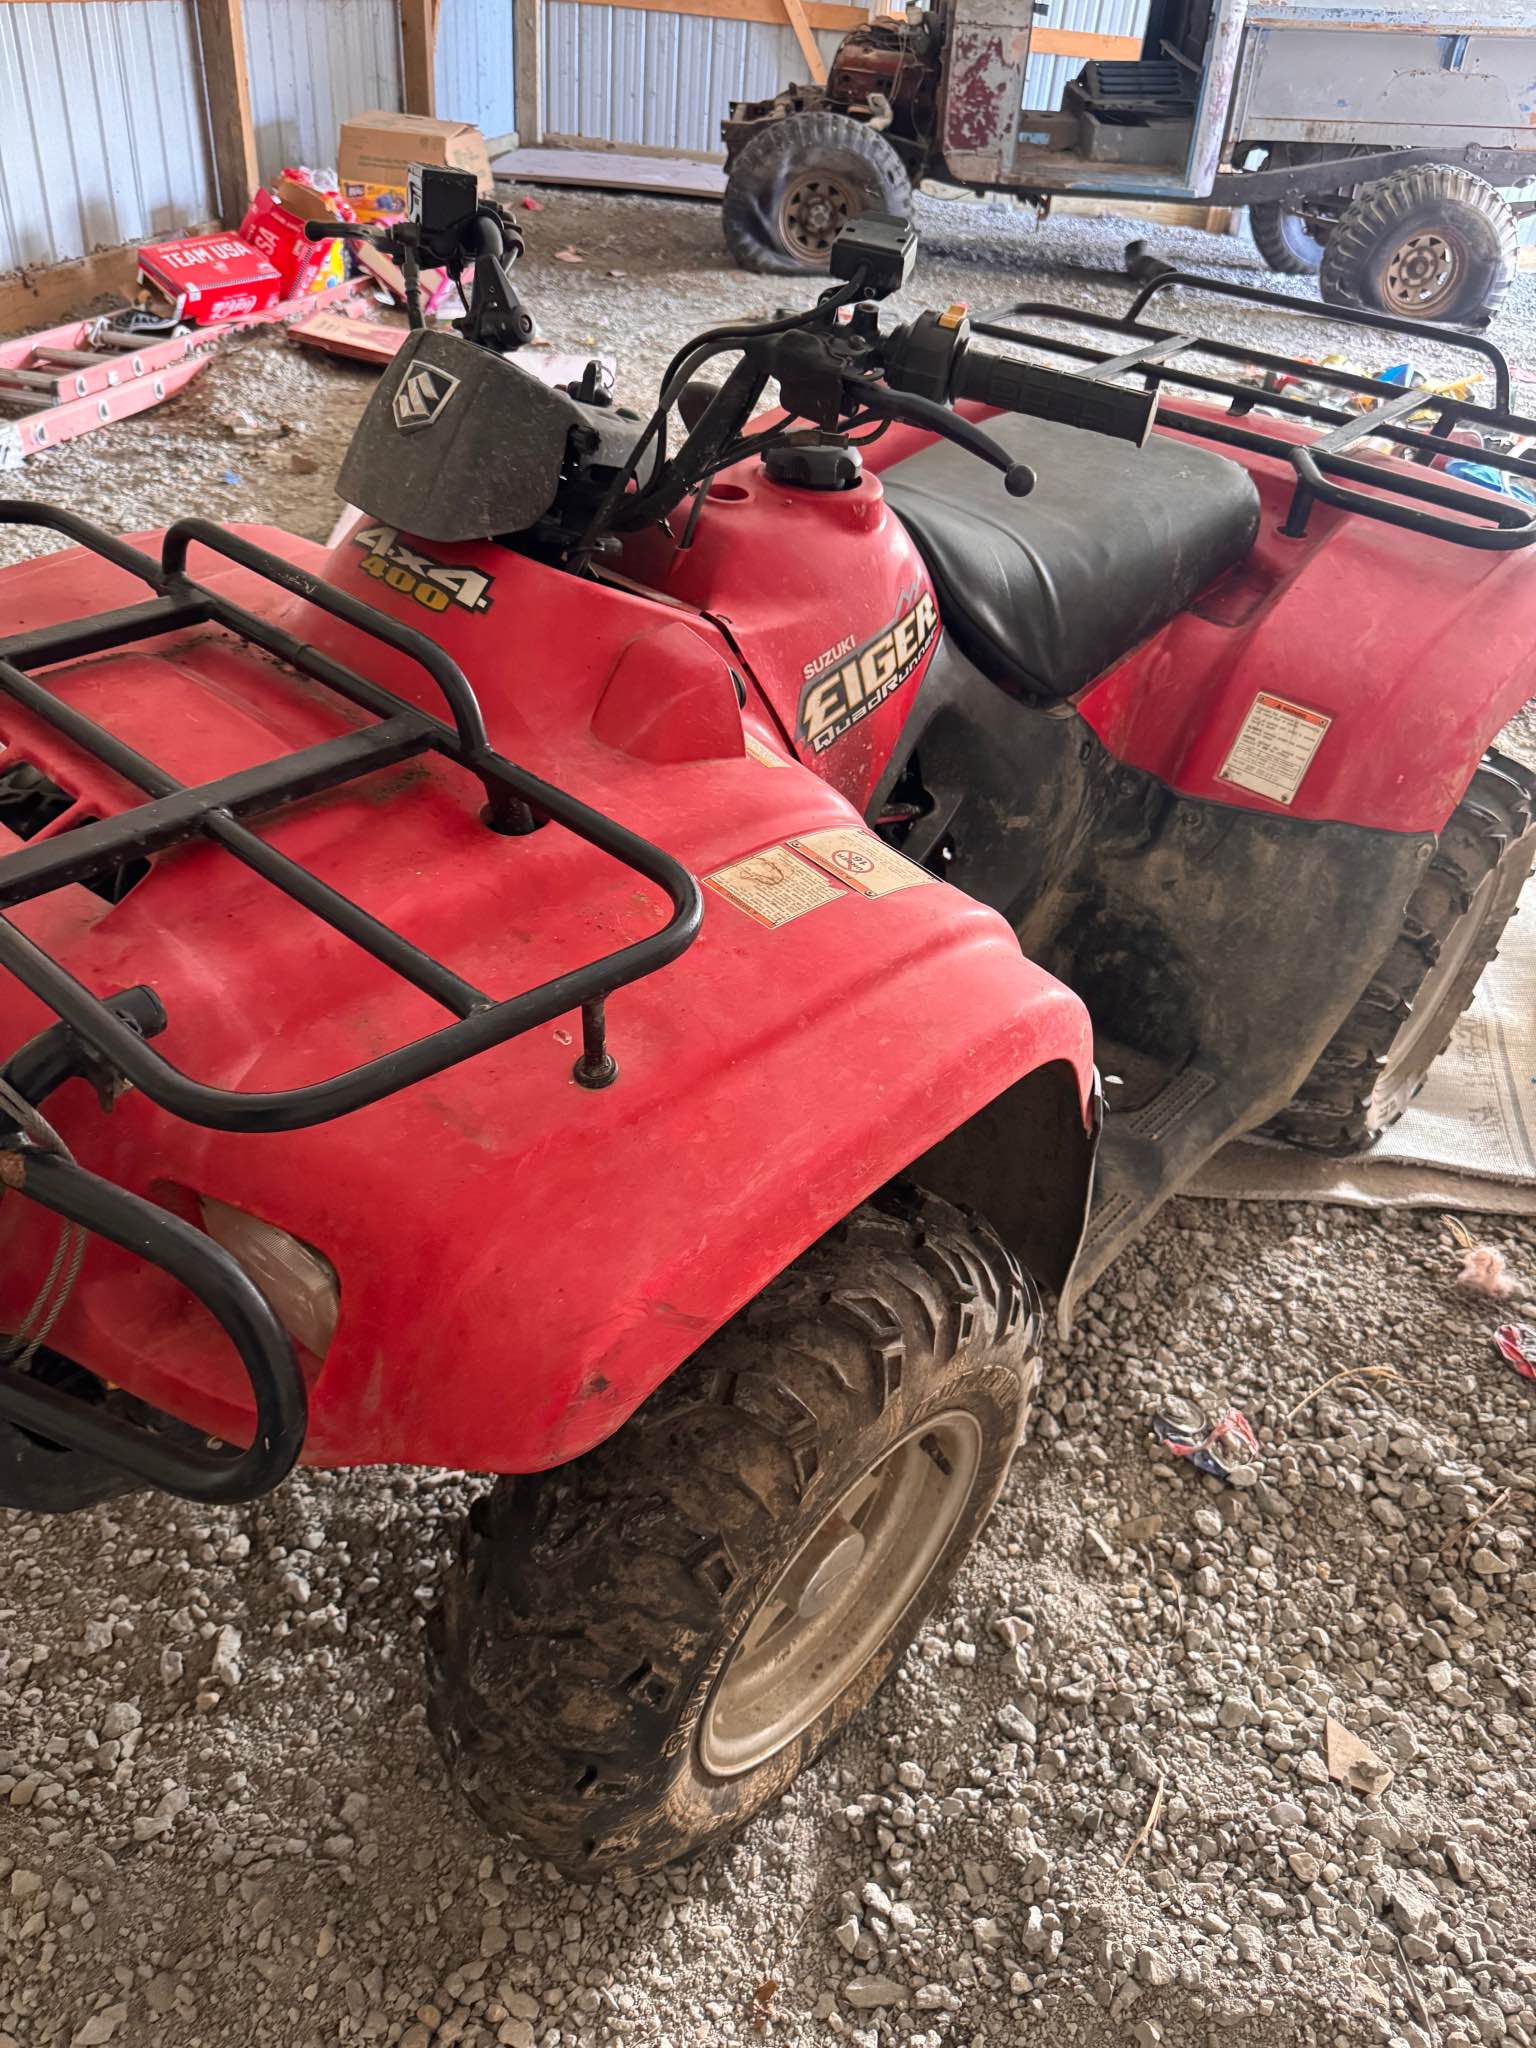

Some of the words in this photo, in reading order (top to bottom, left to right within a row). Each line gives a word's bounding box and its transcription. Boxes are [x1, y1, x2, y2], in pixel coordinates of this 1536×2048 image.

[160, 248, 215, 270] TEAM
[208, 241, 254, 260] USA
[361, 553, 449, 611] 400
[802, 634, 857, 681] SUZUKI
[802, 590, 938, 744] EIGER
